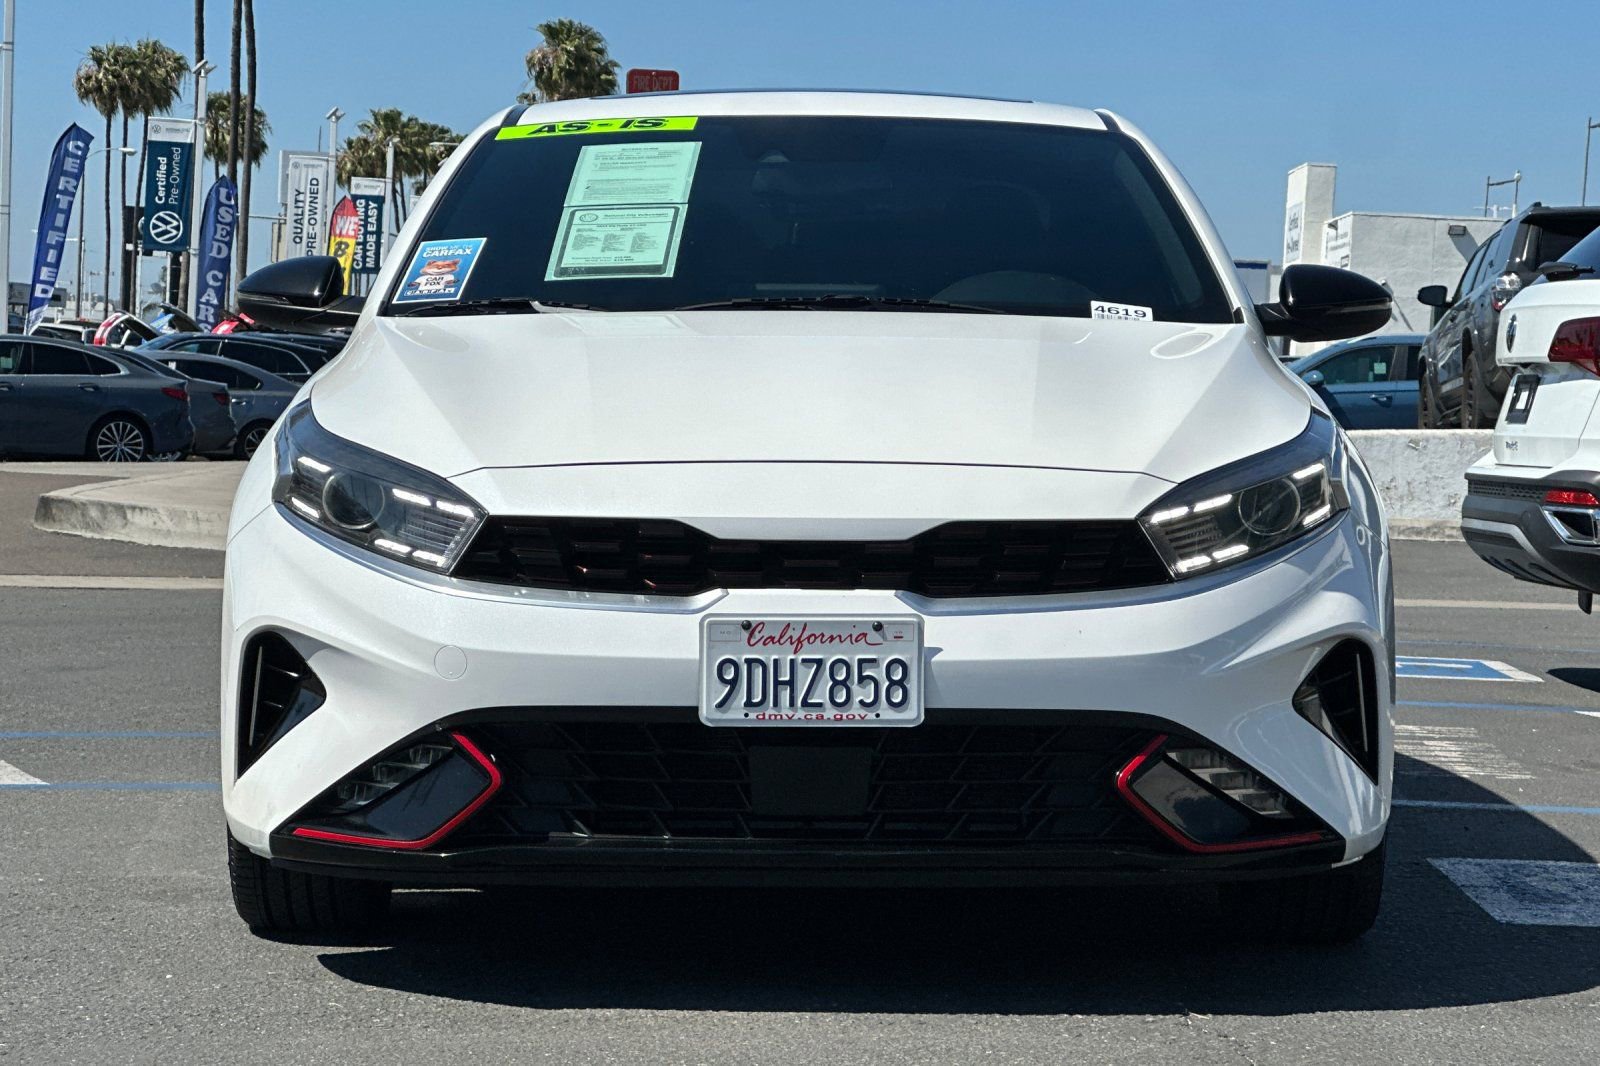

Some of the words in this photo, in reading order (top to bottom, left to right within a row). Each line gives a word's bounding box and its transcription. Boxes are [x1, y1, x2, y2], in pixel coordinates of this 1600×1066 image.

[155, 156, 168, 204] Certified
[168, 146, 182, 205] Pre-Owned
[34, 140, 85, 298] CERTIFIED
[209, 186, 235, 259] USED
[292, 188, 305, 245] QUALITY
[306, 177, 320, 256] PRE-OWNED
[367, 200, 378, 232] EASY
[353, 245, 363, 270] CAR
[366, 234, 377, 268] MADE
[422, 247, 473, 258] CARFAX
[1094, 305, 1147, 318] 4619
[746, 621, 884, 655] California
[714, 657, 909, 708] 9DHZ858
[755, 712, 869, 721] dmv.ca.gov
